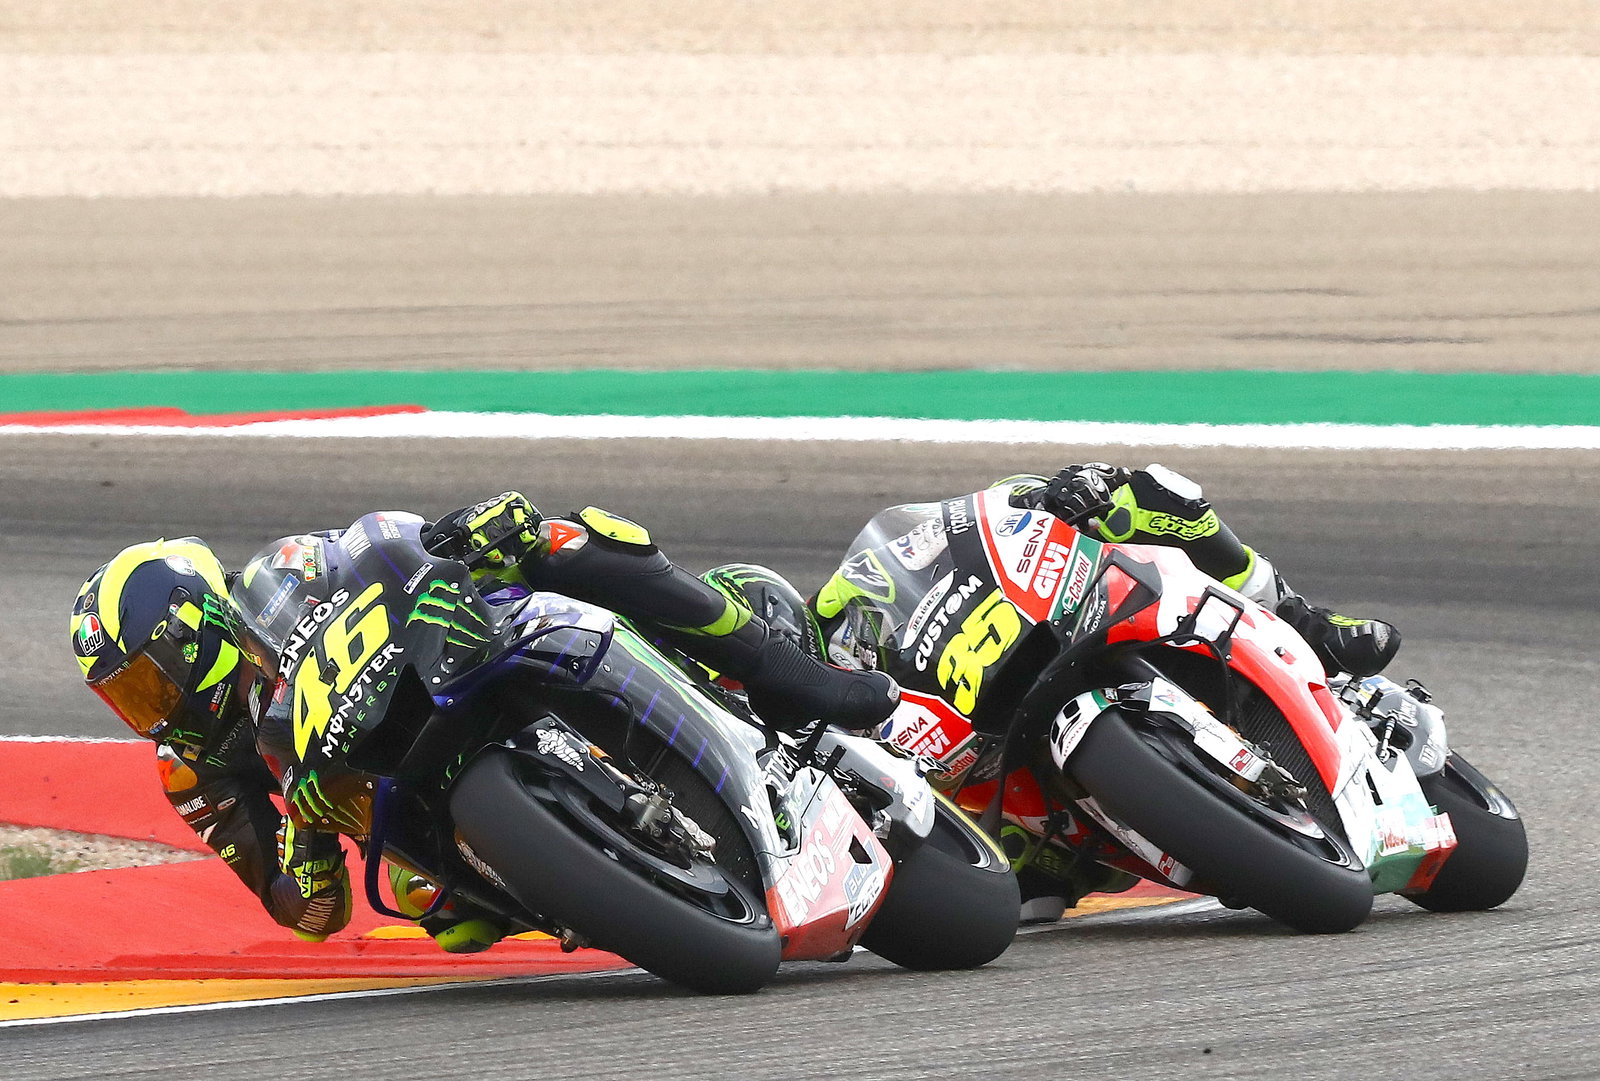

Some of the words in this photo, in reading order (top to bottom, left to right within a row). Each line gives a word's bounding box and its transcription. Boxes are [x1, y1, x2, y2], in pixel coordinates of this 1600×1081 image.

[1017, 517, 1049, 573] SENA
[1033, 541, 1070, 600] GIVI
[1067, 556, 1091, 601] Castrol
[279, 588, 350, 680] ENEOS
[915, 574, 983, 672] CUSTOM
[937, 586, 1022, 716] 35
[293, 582, 391, 763] 46
[322, 643, 405, 759] MONSTER
[341, 666, 399, 754] ENERGY
[892, 717, 928, 746] ENA
[220, 843, 236, 859] 46
[775, 829, 837, 925] ENEOS
